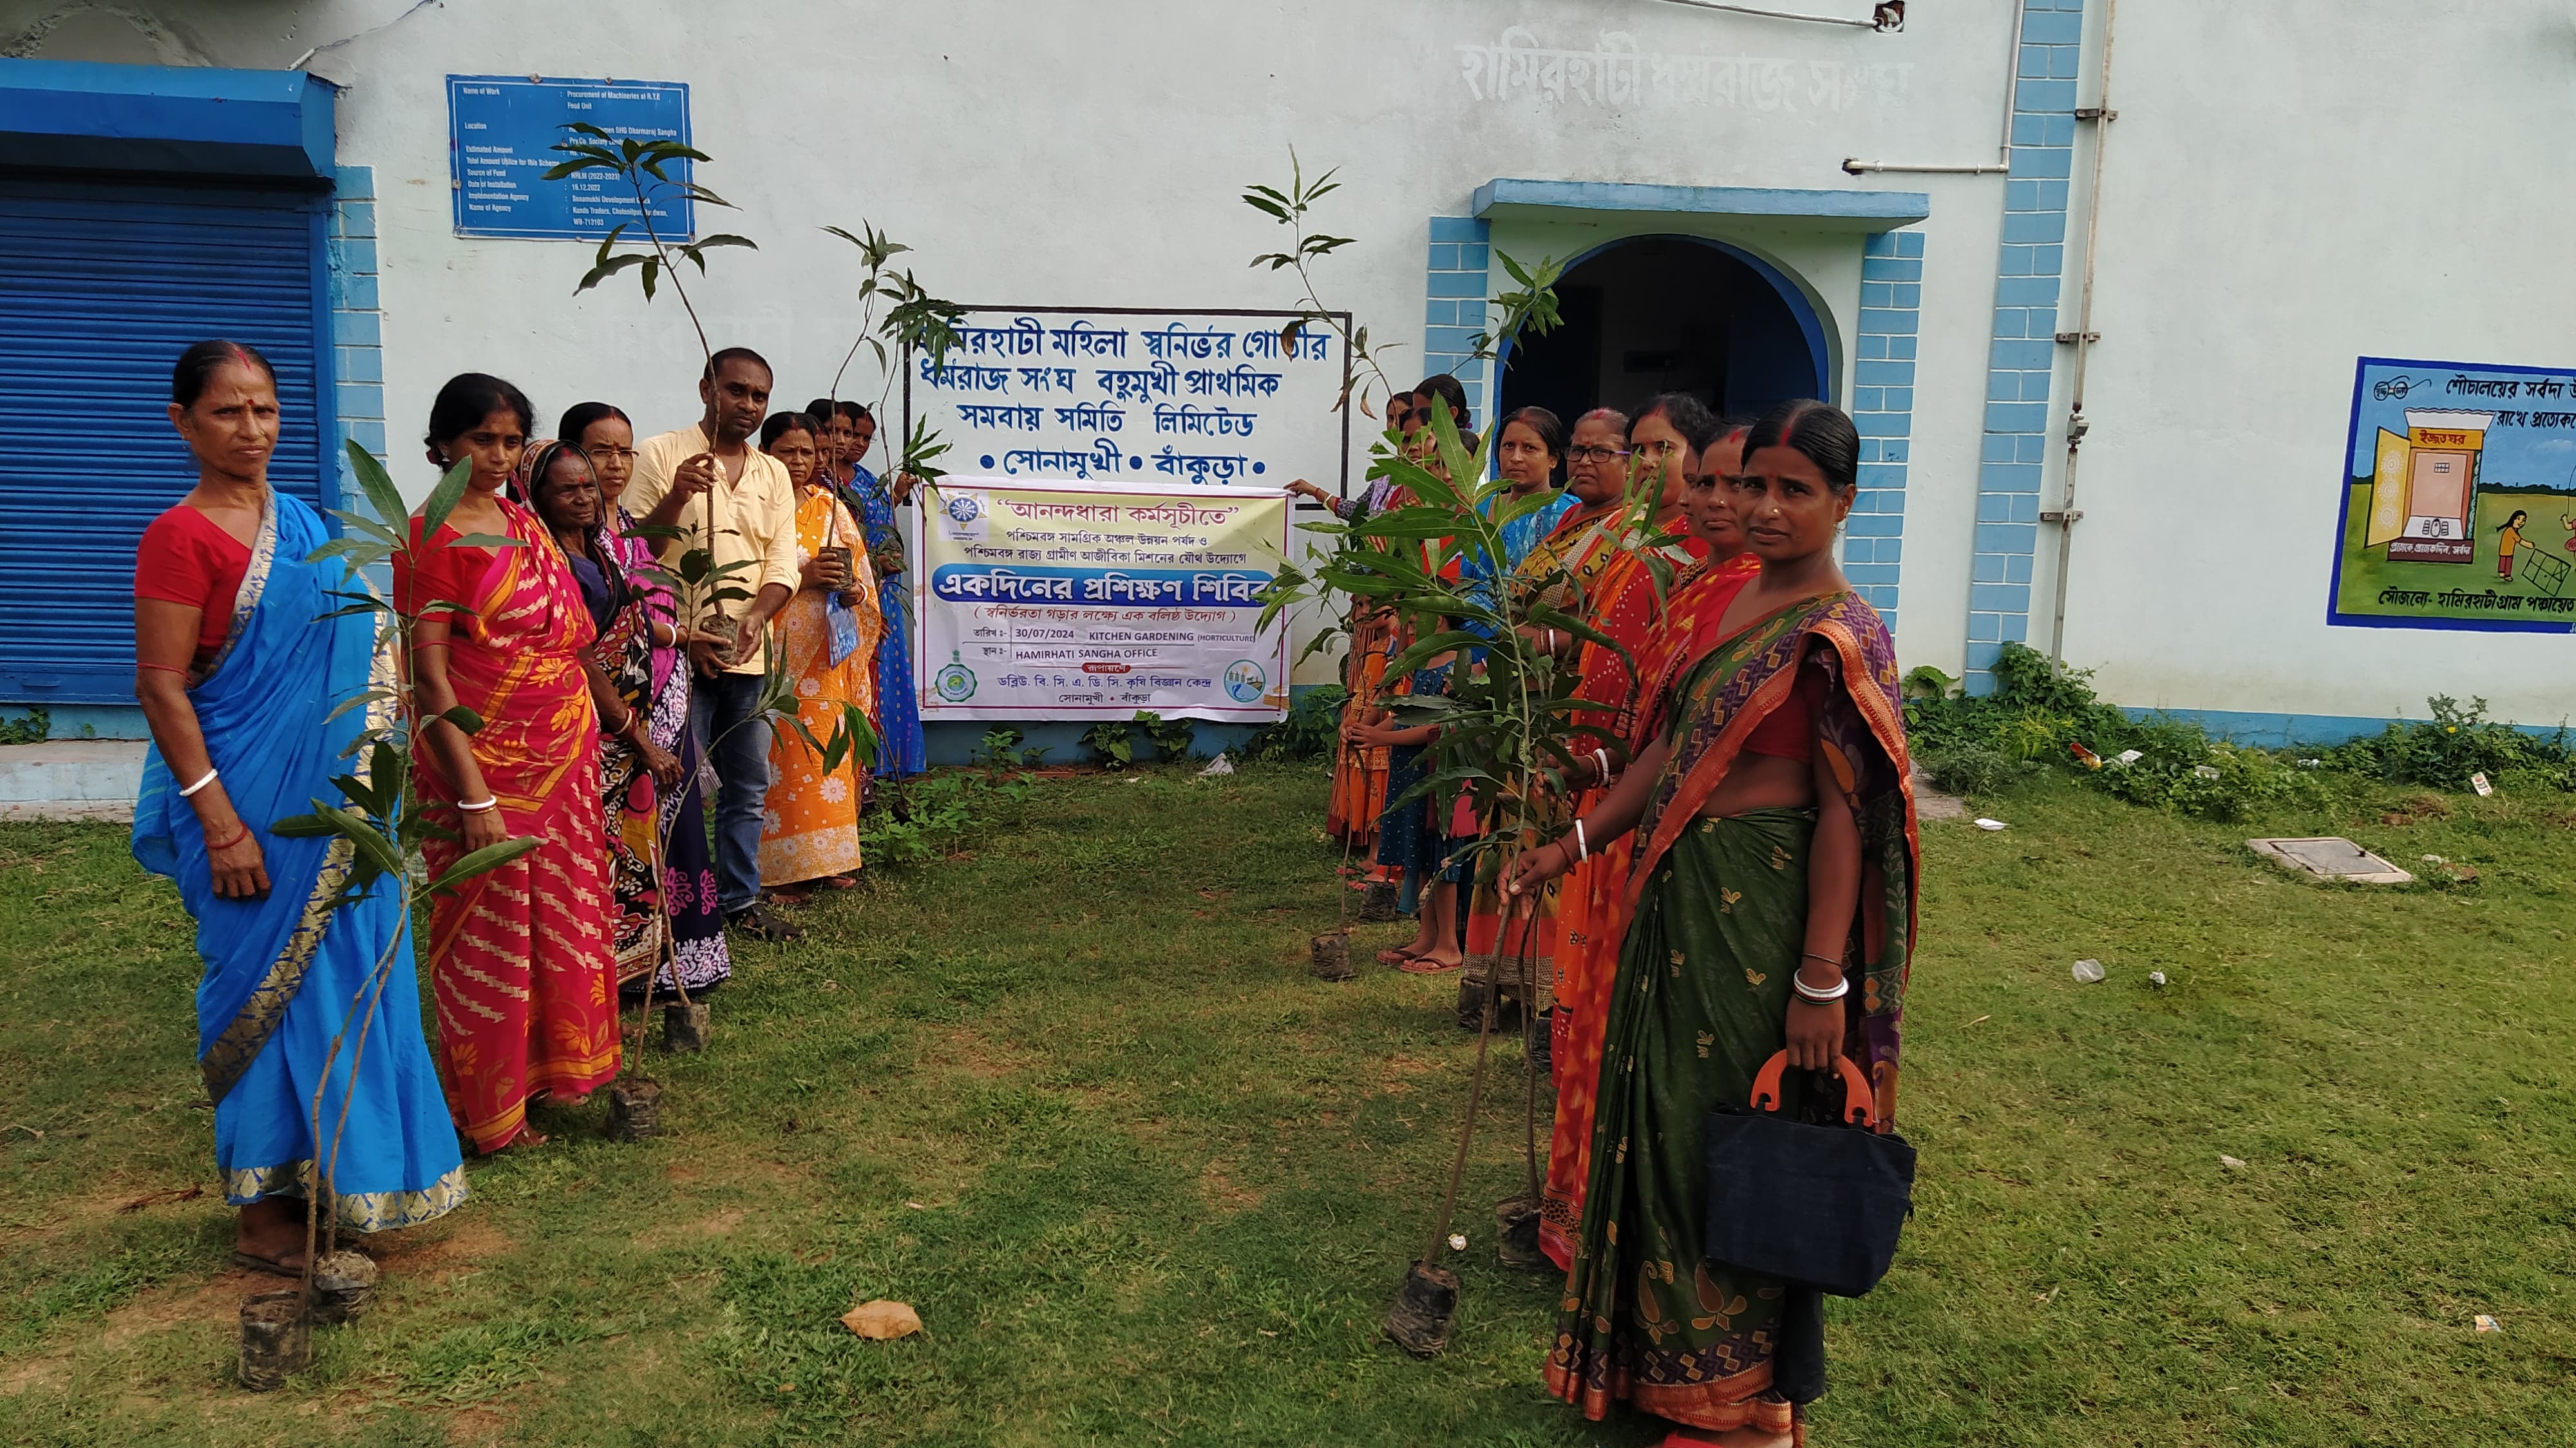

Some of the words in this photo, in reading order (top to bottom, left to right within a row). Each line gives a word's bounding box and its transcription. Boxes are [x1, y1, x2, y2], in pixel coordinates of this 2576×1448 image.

[608, 91, 639, 100] Machineries
[628, 128, 656, 137] Dharmaraj
[589, 138, 607, 146] Society
[589, 173, 620, 181] (2022-2023)
[509, 193, 529, 202] Agency
[601, 196, 636, 204] Development
[492, 204, 511, 213] Agency
[1052, 319, 1128, 359] মহিলা
[1141, 323, 1236, 361] স্বনির্ভর
[920, 357, 1012, 395] ধর্মরাজ
[1096, 361, 1180, 403] বহুমুখী
[1184, 363, 1283, 398] প্রাথমিক
[2446, 373, 2521, 399] শৌচালয়ের
[2524, 377, 2565, 401] সর্বদা
[956, 403, 1045, 432] সমবায়
[1054, 399, 1126, 433] সমিতি
[1153, 403, 1257, 437] লিমিটেড
[2497, 410, 2529, 428] রাখে
[2419, 430, 2447, 444] ইজ্জত
[2448, 433, 2467, 445] ঘর
[1004, 437, 1122, 481] সোনামুখী
[1151, 444, 1248, 485] বাঁকুড়া
[1006, 527, 1056, 542] পশ্চিমবঙ্গ
[1059, 529, 1102, 544] সামগ্রিক
[1104, 533, 1133, 545] অঞ্চল
[1138, 533, 1168, 546] উন্নয়ন
[1198, 537, 1208, 546] ও
[964, 544, 1013, 560] পশ্চিমবঙ্গ
[1016, 548, 1042, 561] রাজ্য
[1046, 547, 1077, 562] গ্রামীণ
[1080, 548, 1130, 564] আজীবিকা
[1133, 549, 1174, 564] মিশনের
[1179, 551, 1202, 564] যৌথ
[1206, 551, 1247, 565] উদ্যোগে
[938, 568, 1074, 600] একদিনের
[1083, 571, 1184, 602] প্রশিক্ষণ
[2438, 587, 2497, 610] হামিরহাটী
[2497, 595, 2524, 611] গ্রাম
[985, 604, 1042, 619] স্বনির্ভরতা
[1047, 609, 1079, 622] গড়ার
[1122, 611, 1144, 622] এক
[1148, 608, 1180, 622] বলিষ্ঠ
[1184, 609, 1226, 622] উদ্যোগ
[972, 626, 997, 637] তারিখ
[1016, 629, 1074, 640] 30/07/2024
[1089, 632, 1132, 641] KITCHEN
[1134, 632, 1194, 642] GARDENING
[981, 647, 996, 657] স্থান
[1016, 650, 1074, 660] HAMIRHATI
[1078, 649, 1121, 658] SANGHA
[1124, 649, 1158, 657] OFFICE
[1034, 674, 1049, 687] বি.
[1053, 675, 1068, 688] সি.
[1072, 678, 1084, 687] এ.
[1088, 675, 1103, 687] ডি.
[1107, 676, 1122, 688] সি.
[1126, 676, 1146, 691] কৃষি
[1150, 676, 1182, 688] বিজ্ঞান
[1187, 678, 1211, 689] কেন্দ্র
[1059, 692, 1104, 705] সোনামুখী
[1119, 692, 1151, 705] বাঁকুড়া
